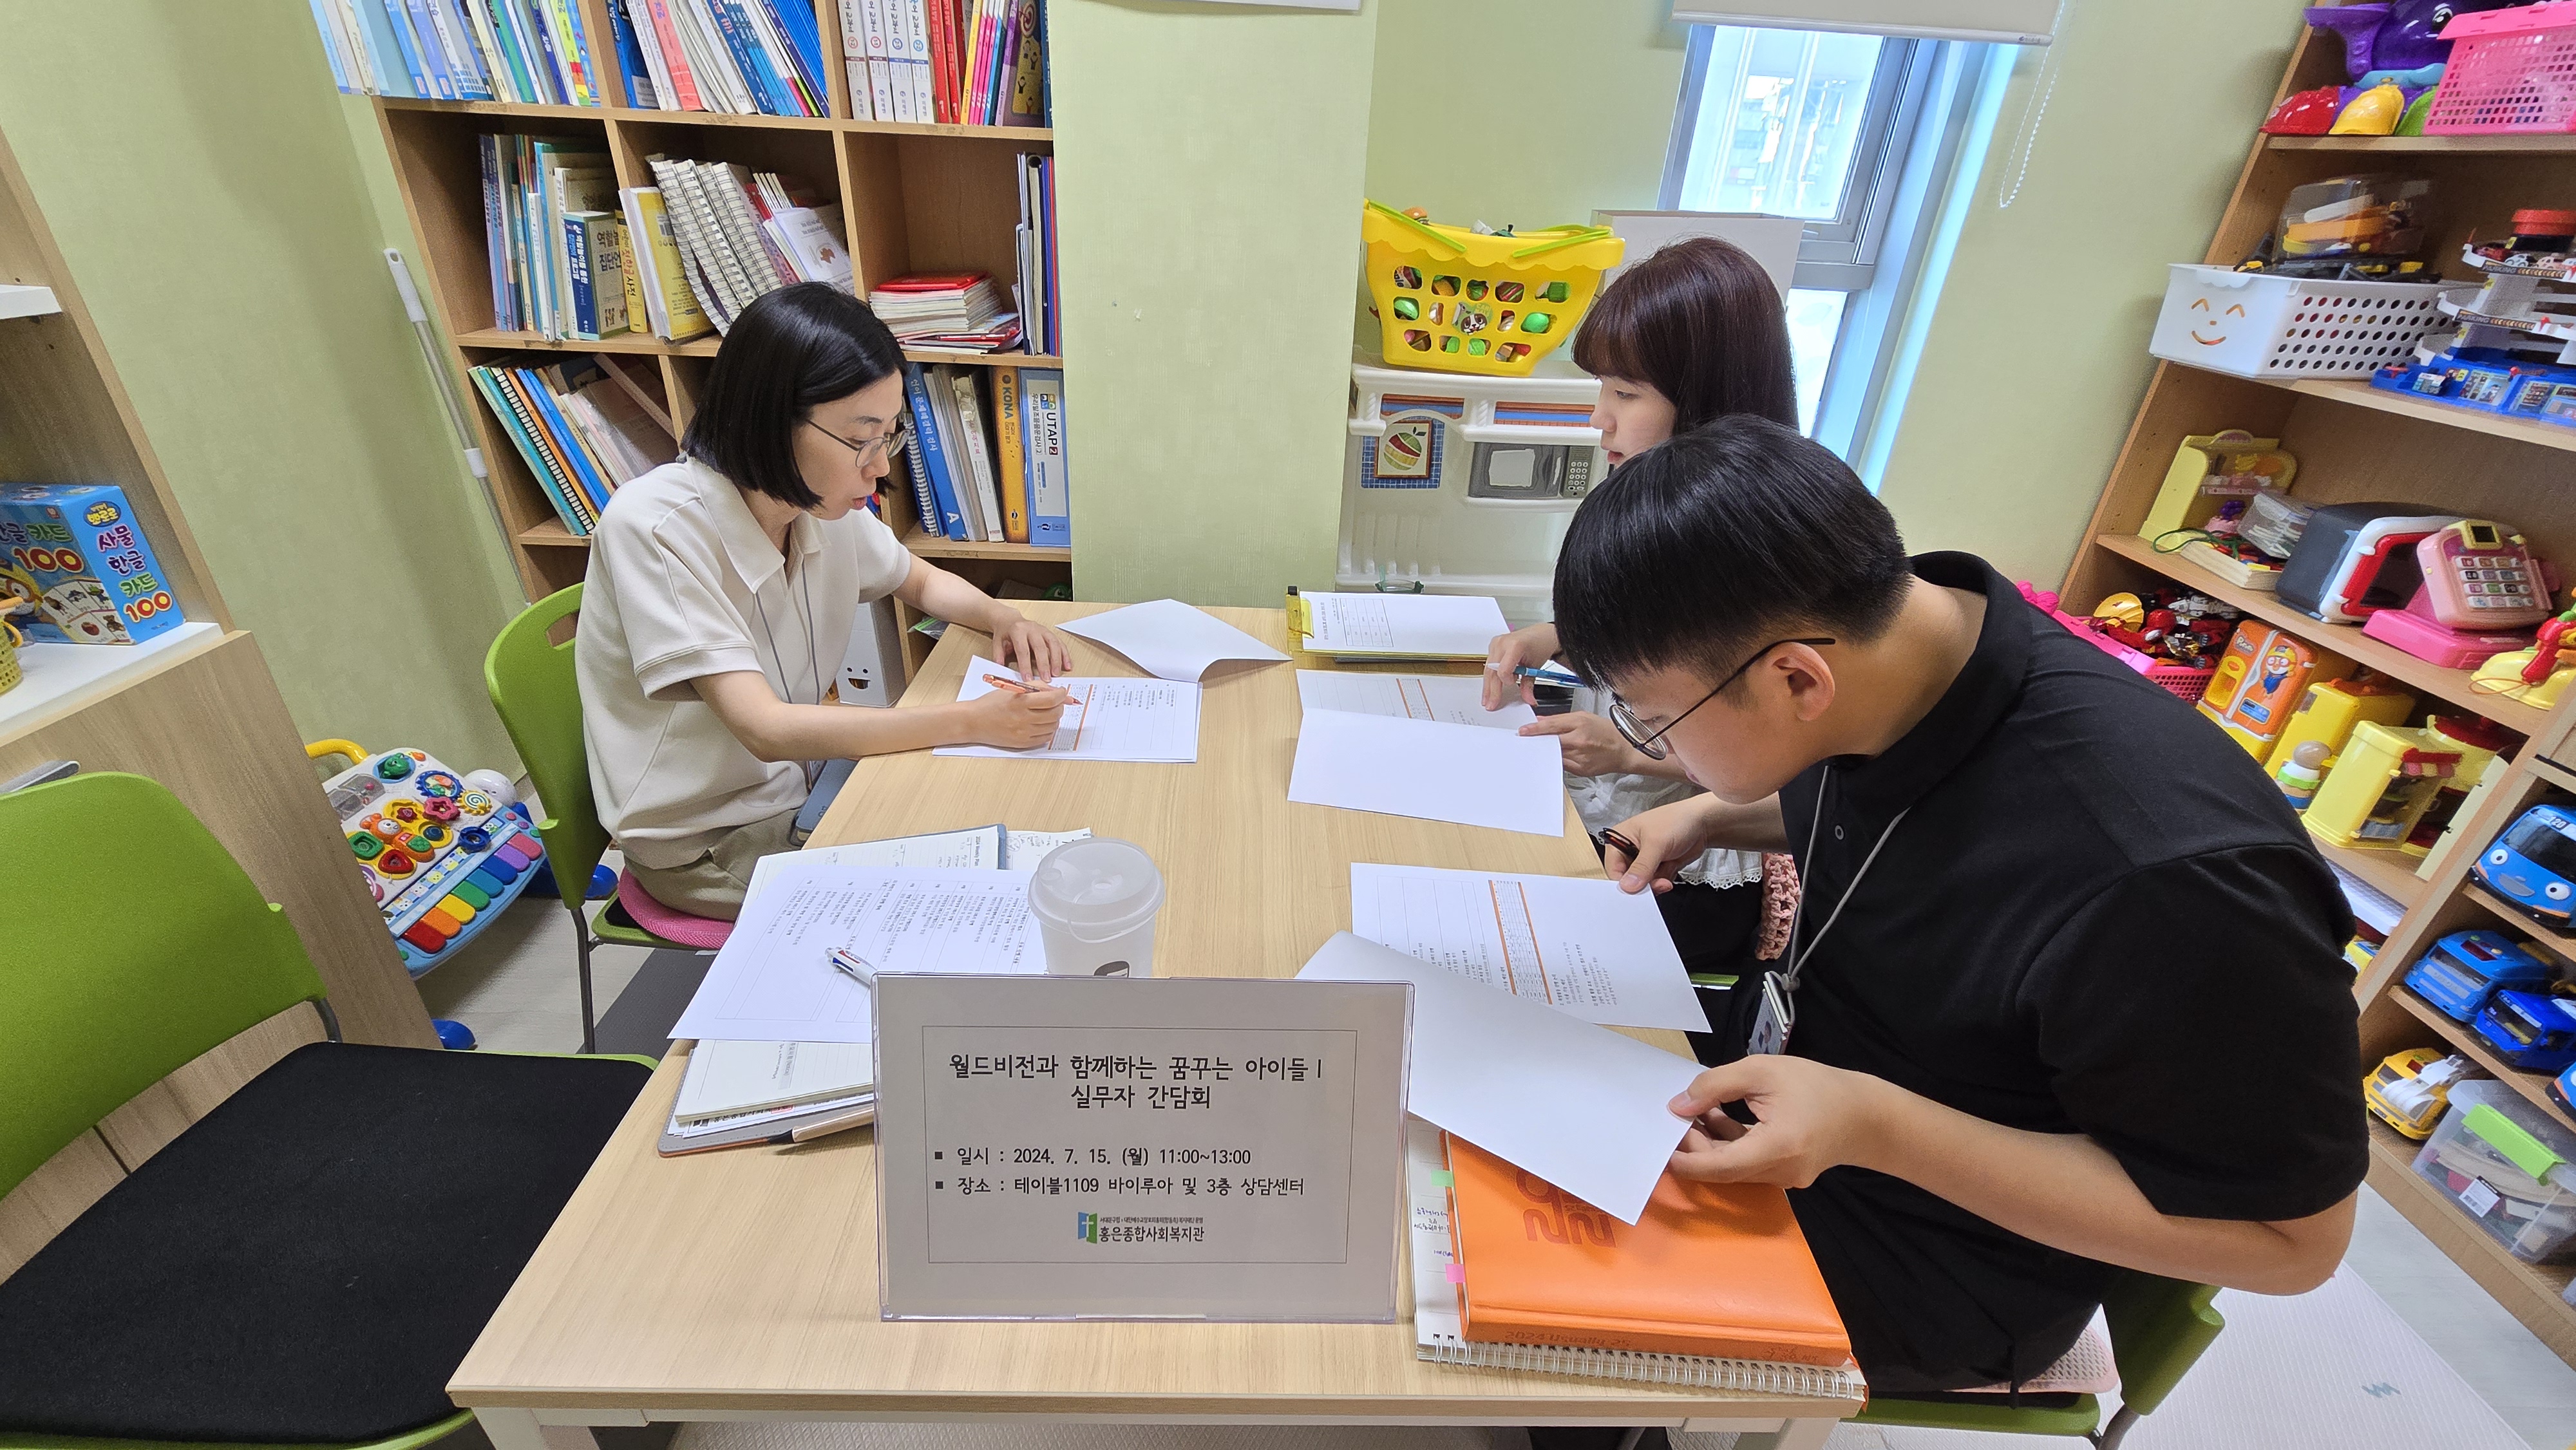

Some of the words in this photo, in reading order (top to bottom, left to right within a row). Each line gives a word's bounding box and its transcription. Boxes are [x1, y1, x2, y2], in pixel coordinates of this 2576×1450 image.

[846, 12, 855, 32] 교과서
[912, 15, 920, 36] 교과서
[575, 236, 587, 271] 역할놀이를
[571, 256, 580, 280] 프로그램
[580, 271, 589, 284] 통한
[623, 276, 636, 296] 사전
[2457, 315, 2490, 323] PARKING
[910, 379, 922, 395] 언어
[1002, 386, 1014, 419] KONA
[915, 396, 933, 435] 문제해결력
[926, 437, 938, 451] 검사
[947, 511, 960, 524] A
[26, 523, 72, 542] 카드
[98, 524, 134, 551] 사물
[12, 547, 84, 572] 100
[108, 549, 145, 575] 한글
[119, 572, 158, 598] 카드
[124, 590, 172, 622] 100
[949, 1054, 1059, 1079] 월드비전과
[1070, 1055, 1157, 1080] 함께하는
[1168, 1057, 1233, 1081] 꿈꾸는
[1070, 1084, 1135, 1109] 실무자
[1147, 1085, 1210, 1110] 간담회
[957, 1147, 989, 1166] 일시
[1013, 1148, 1055, 1165] 2024.
[1065, 1148, 1079, 1165] 7.
[1089, 1148, 1112, 1165] 15.
[1122, 1147, 1149, 1167] (월)
[1159, 1148, 1251, 1165] 11:00~13:00
[957, 1176, 991, 1196] 장소
[1014, 1176, 1099, 1196] 테이블1109
[1108, 1176, 1174, 1196] 바이루아
[1182, 1177, 1197, 1196] 및
[1206, 1177, 1233, 1196] 3층
[1240, 1177, 1304, 1196] 상담센터
[1099, 1225, 1205, 1243] 홍은종합사회복지관
